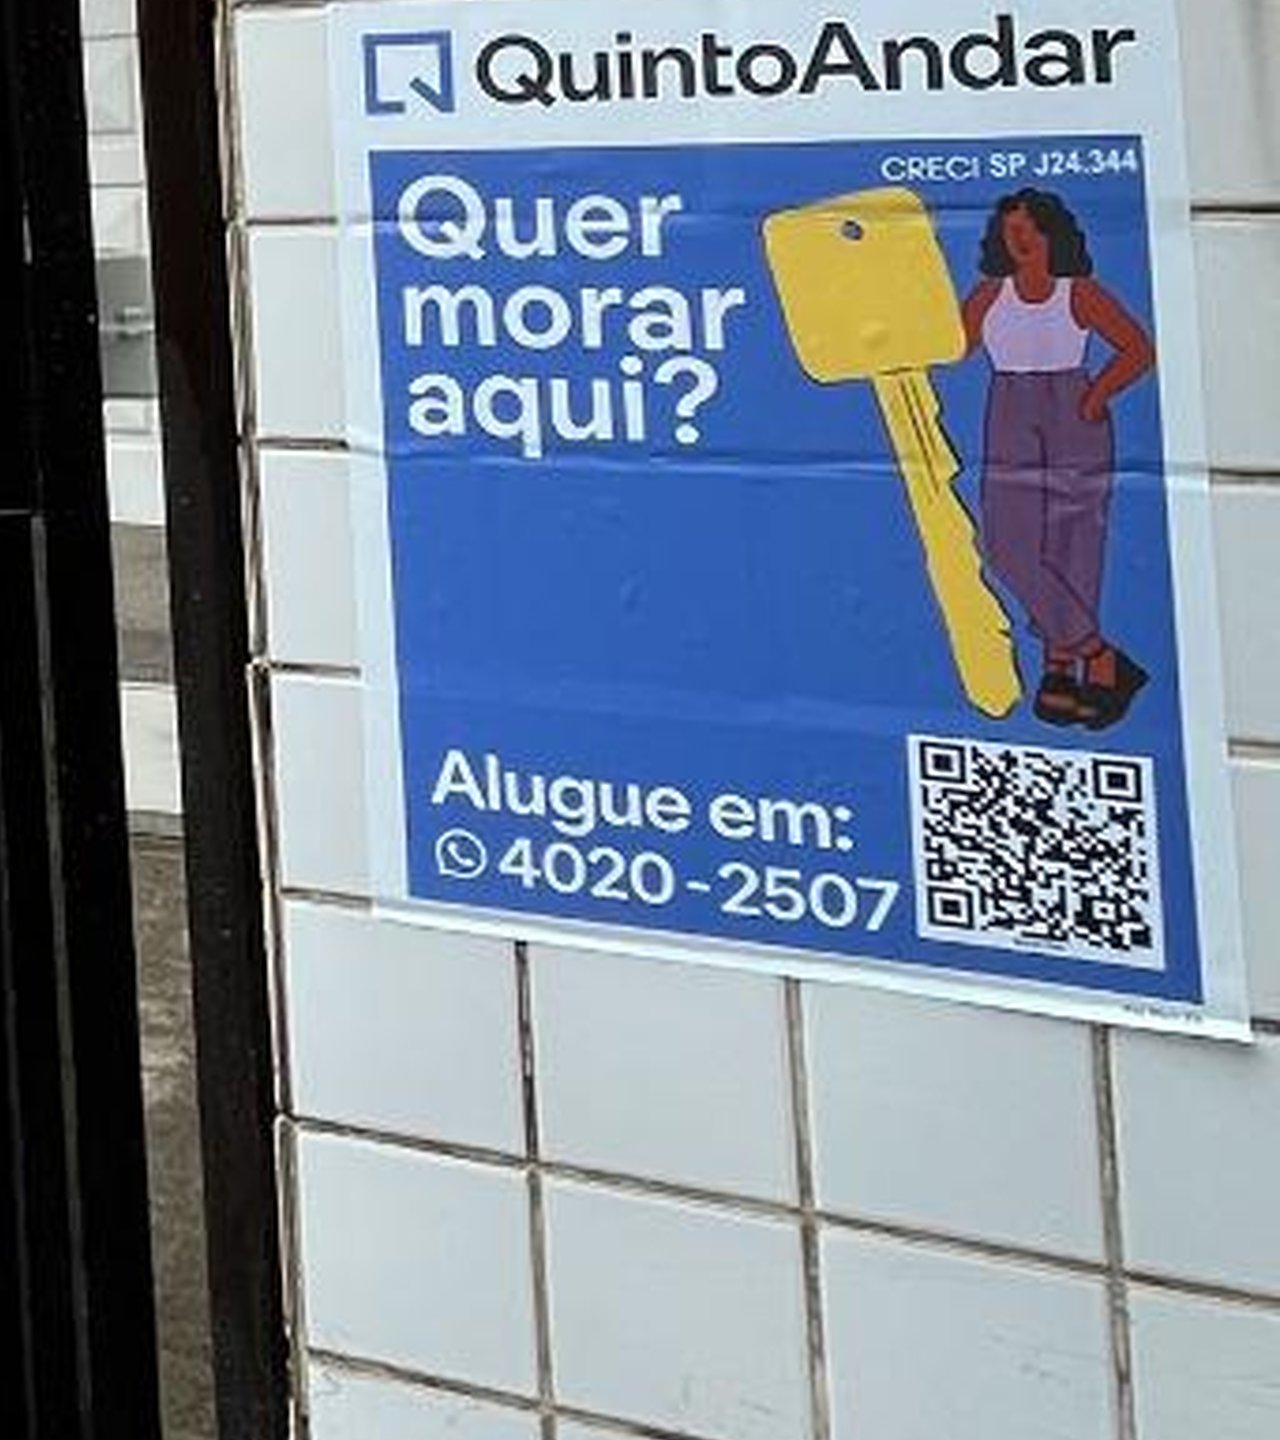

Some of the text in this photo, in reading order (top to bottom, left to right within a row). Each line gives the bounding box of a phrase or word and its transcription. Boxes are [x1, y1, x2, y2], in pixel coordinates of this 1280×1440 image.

[473, 15, 1136, 108] QuintoAndar
[881, 149, 1137, 181] CRECI SP J24.344
[396, 175, 683, 259] Quer
[403, 283, 746, 352] morar
[407, 356, 720, 460] aqui?
[432, 748, 855, 852] Alugue em:
